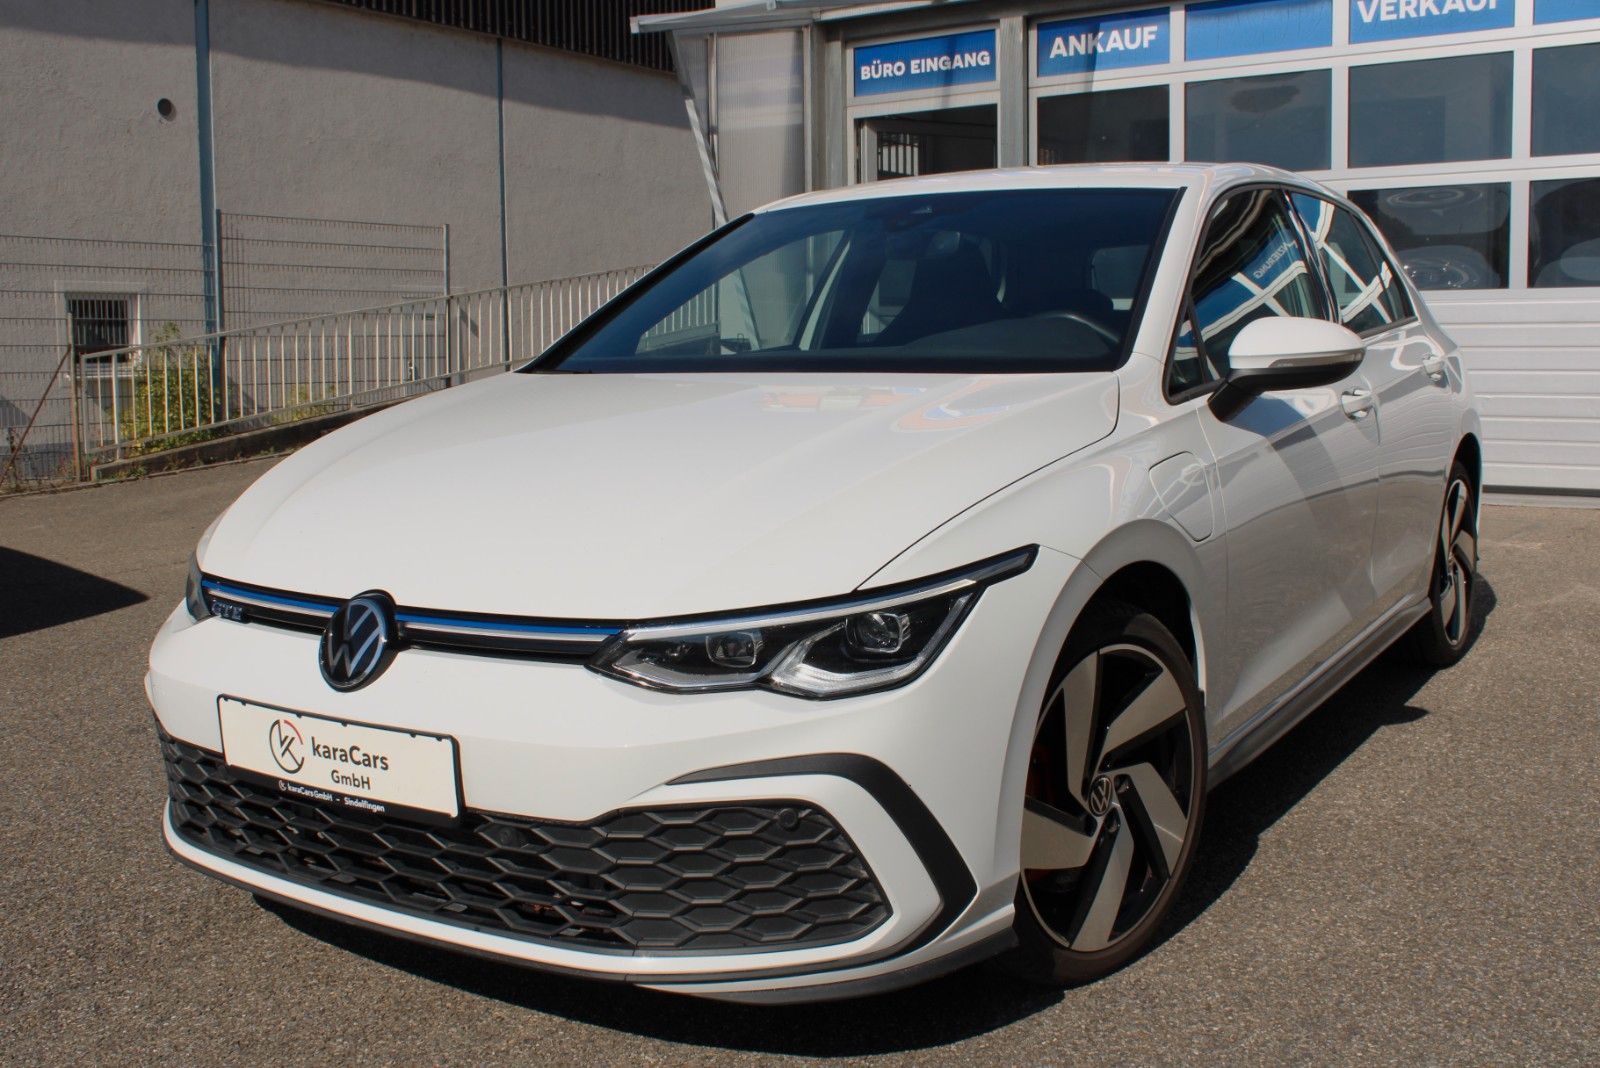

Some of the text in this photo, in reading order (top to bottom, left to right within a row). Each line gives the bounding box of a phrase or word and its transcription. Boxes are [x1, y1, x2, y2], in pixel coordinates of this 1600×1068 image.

[1049, 25, 1159, 59] ANKAUF
[860, 50, 991, 81] BÜRO EINGANG
[311, 736, 389, 771] karaCars
[330, 770, 371, 790] GmbH
[344, 797, 385, 813] Sindelfingen
